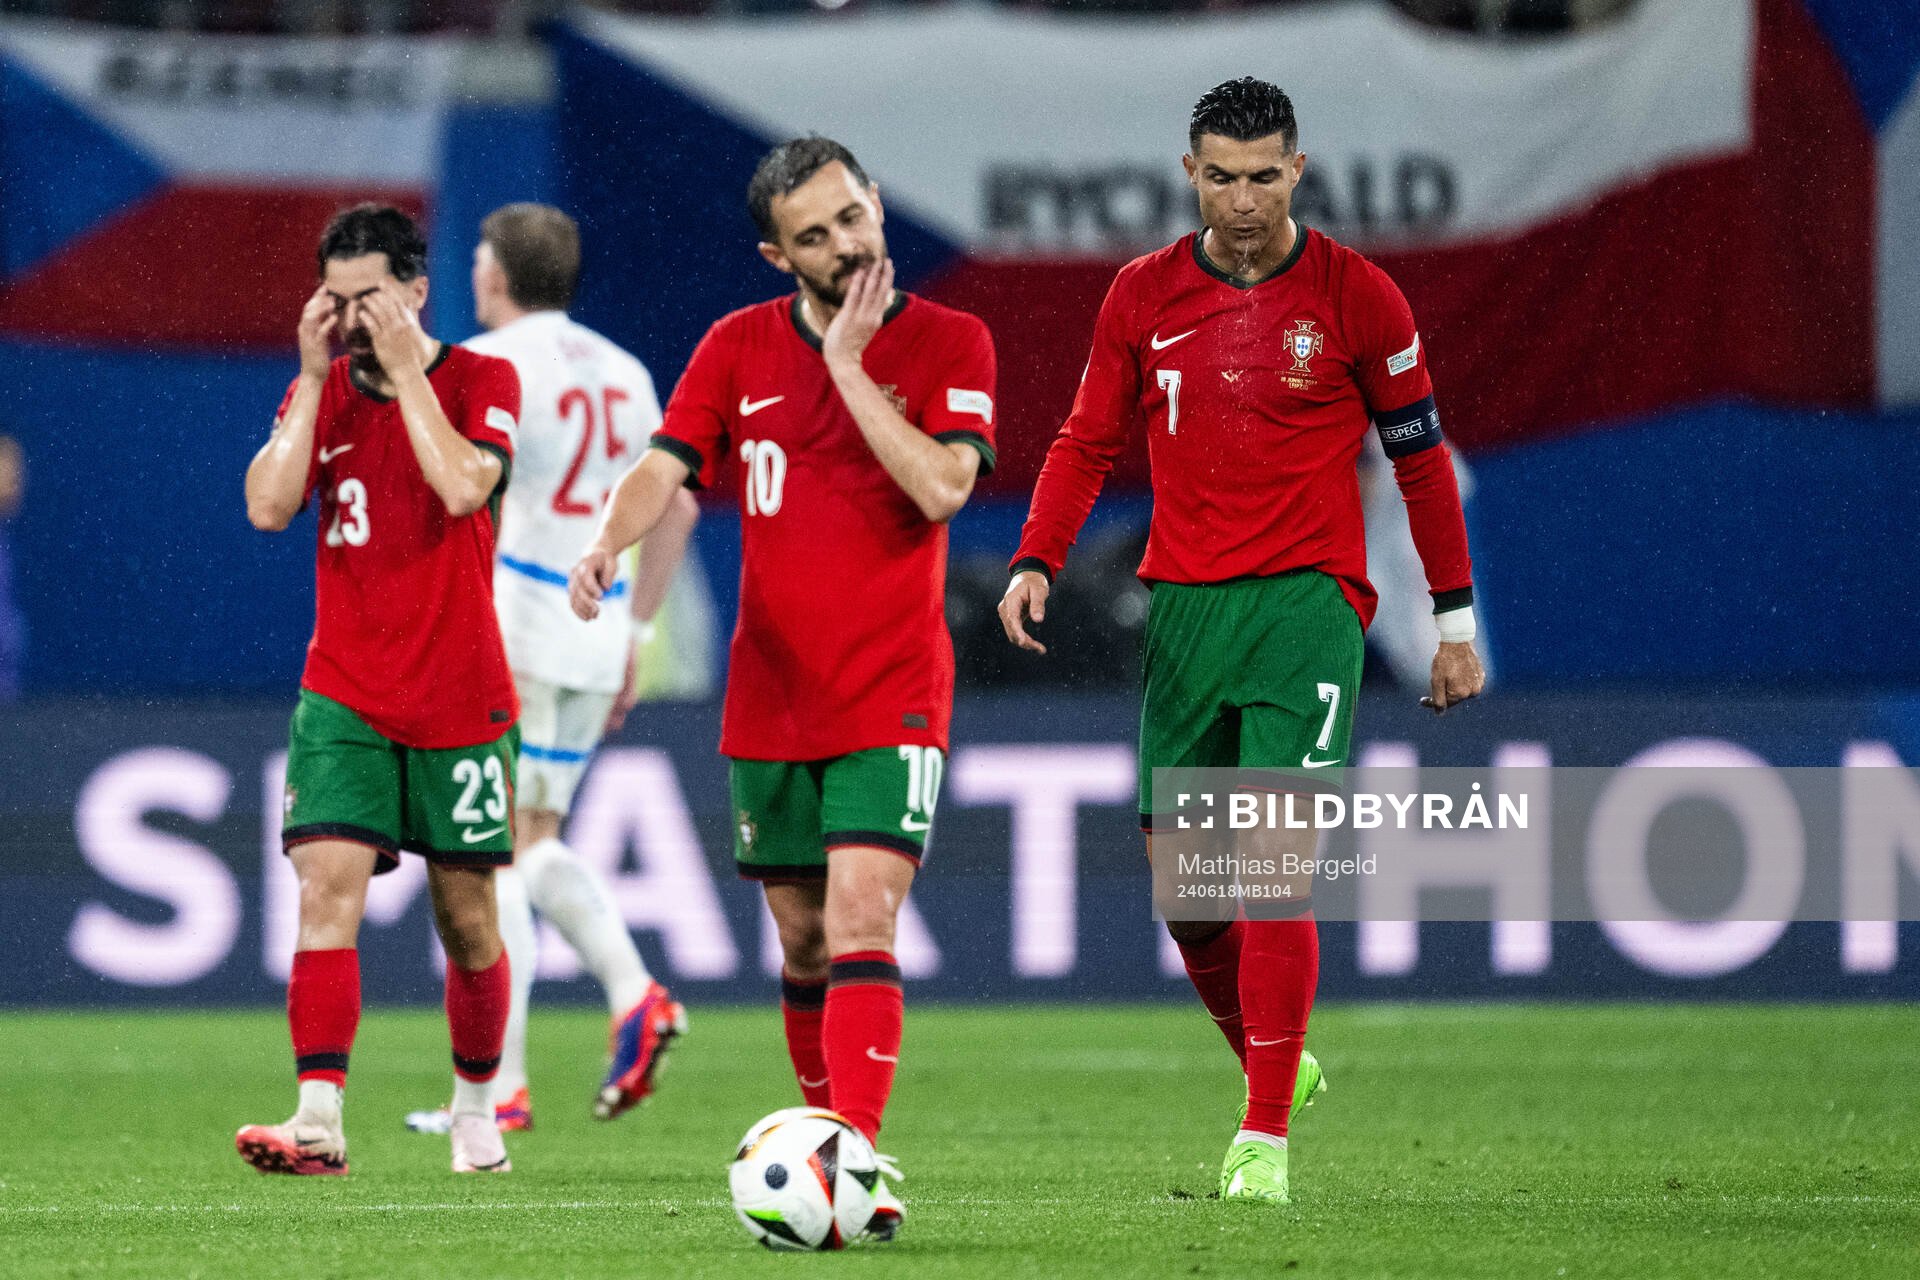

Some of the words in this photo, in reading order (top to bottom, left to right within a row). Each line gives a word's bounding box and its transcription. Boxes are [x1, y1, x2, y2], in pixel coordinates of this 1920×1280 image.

[1157, 370, 1182, 435] 7
[1381, 421, 1423, 440] RESPECT
[739, 438, 787, 517] 10
[1316, 682, 1341, 751] 7
[451, 755, 507, 824] 23
[898, 744, 944, 819] 10
